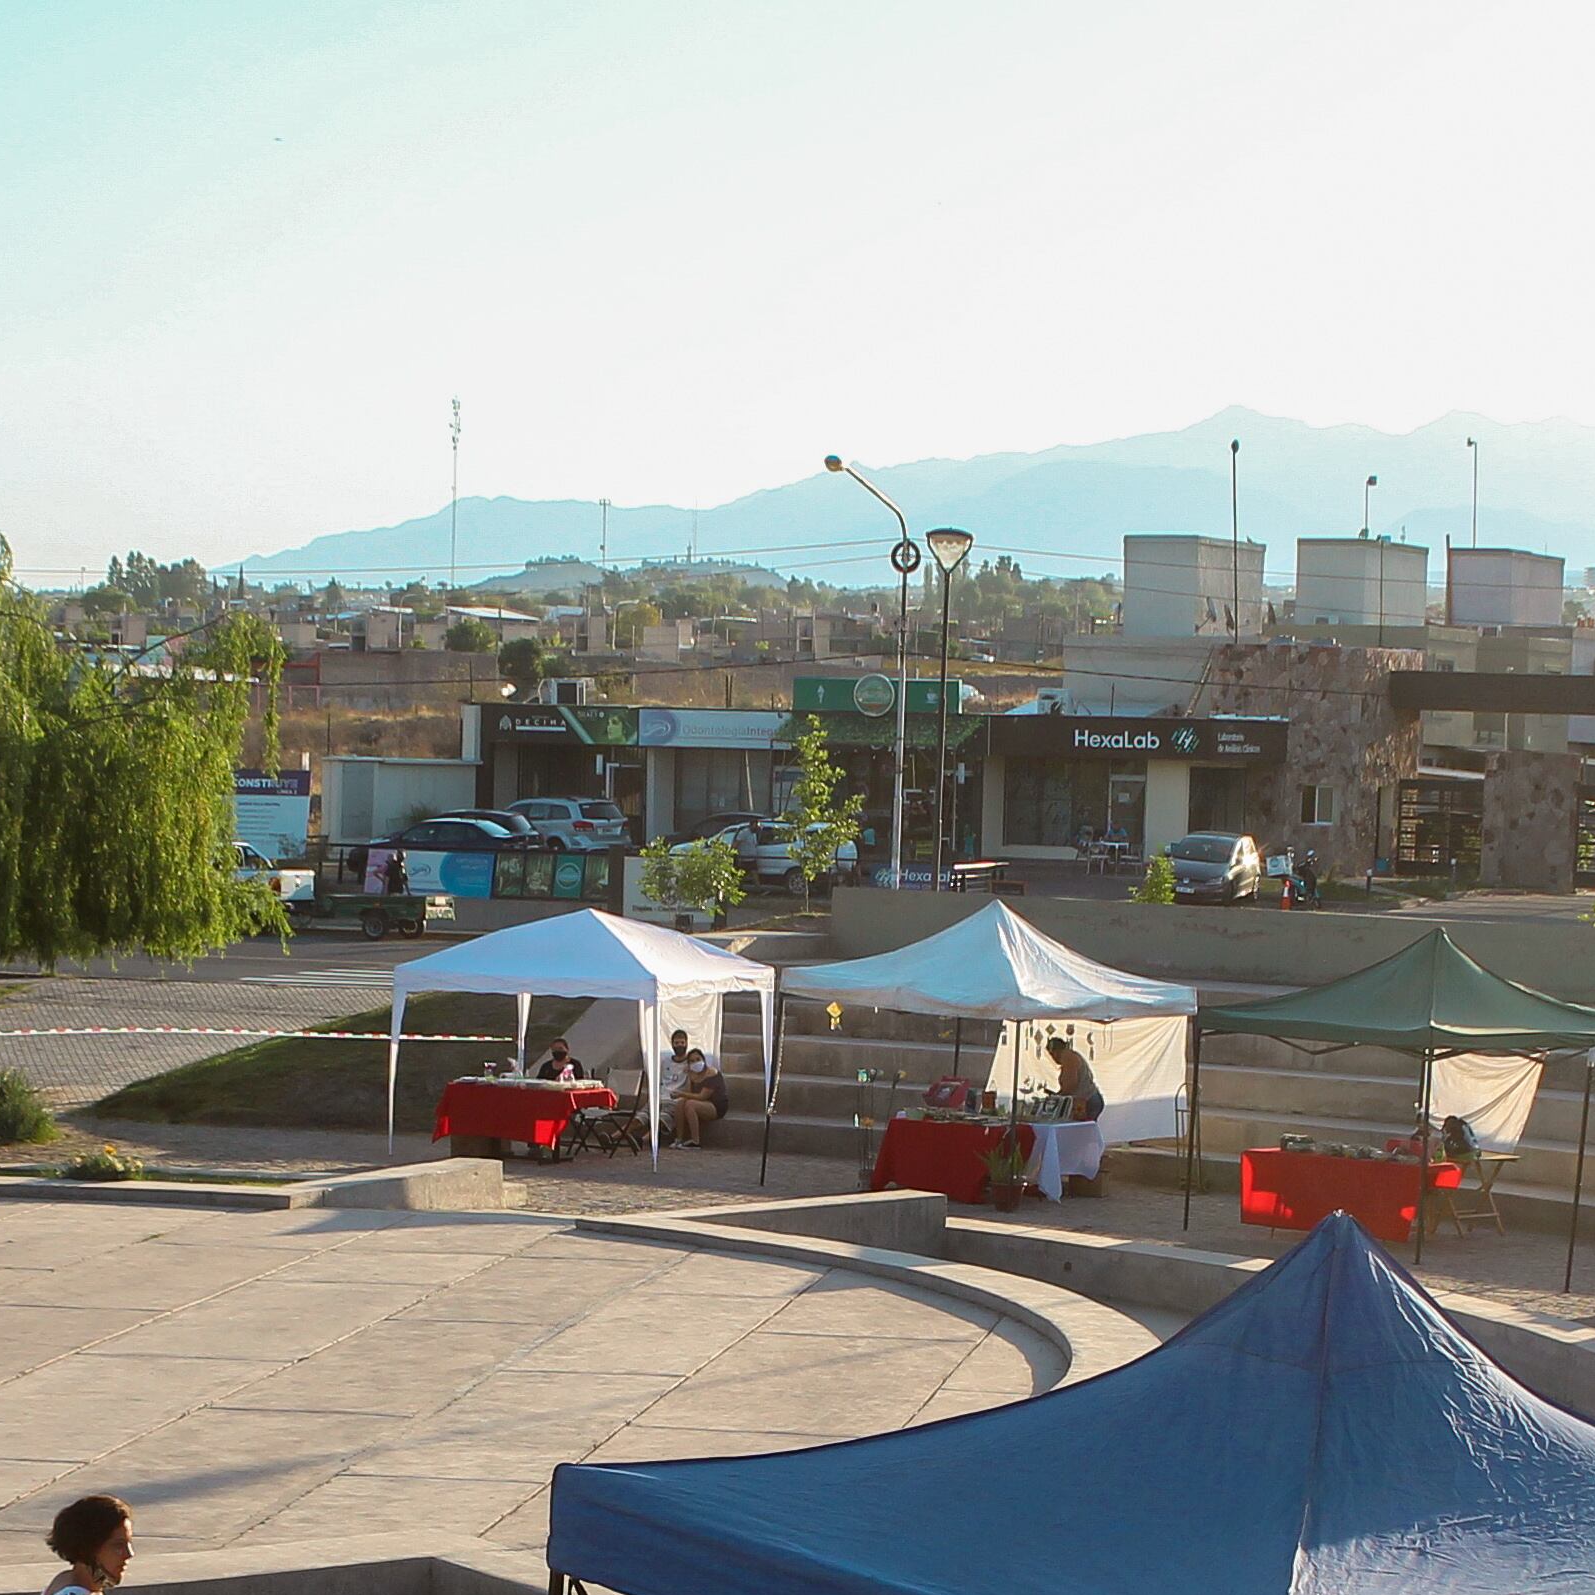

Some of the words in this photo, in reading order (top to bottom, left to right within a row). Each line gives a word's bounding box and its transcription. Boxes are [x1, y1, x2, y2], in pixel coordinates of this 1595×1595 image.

[1074, 729, 1161, 750] HexaLab
[234, 778, 299, 789] ONSTRUYE
[899, 868, 951, 882] Hexaa
